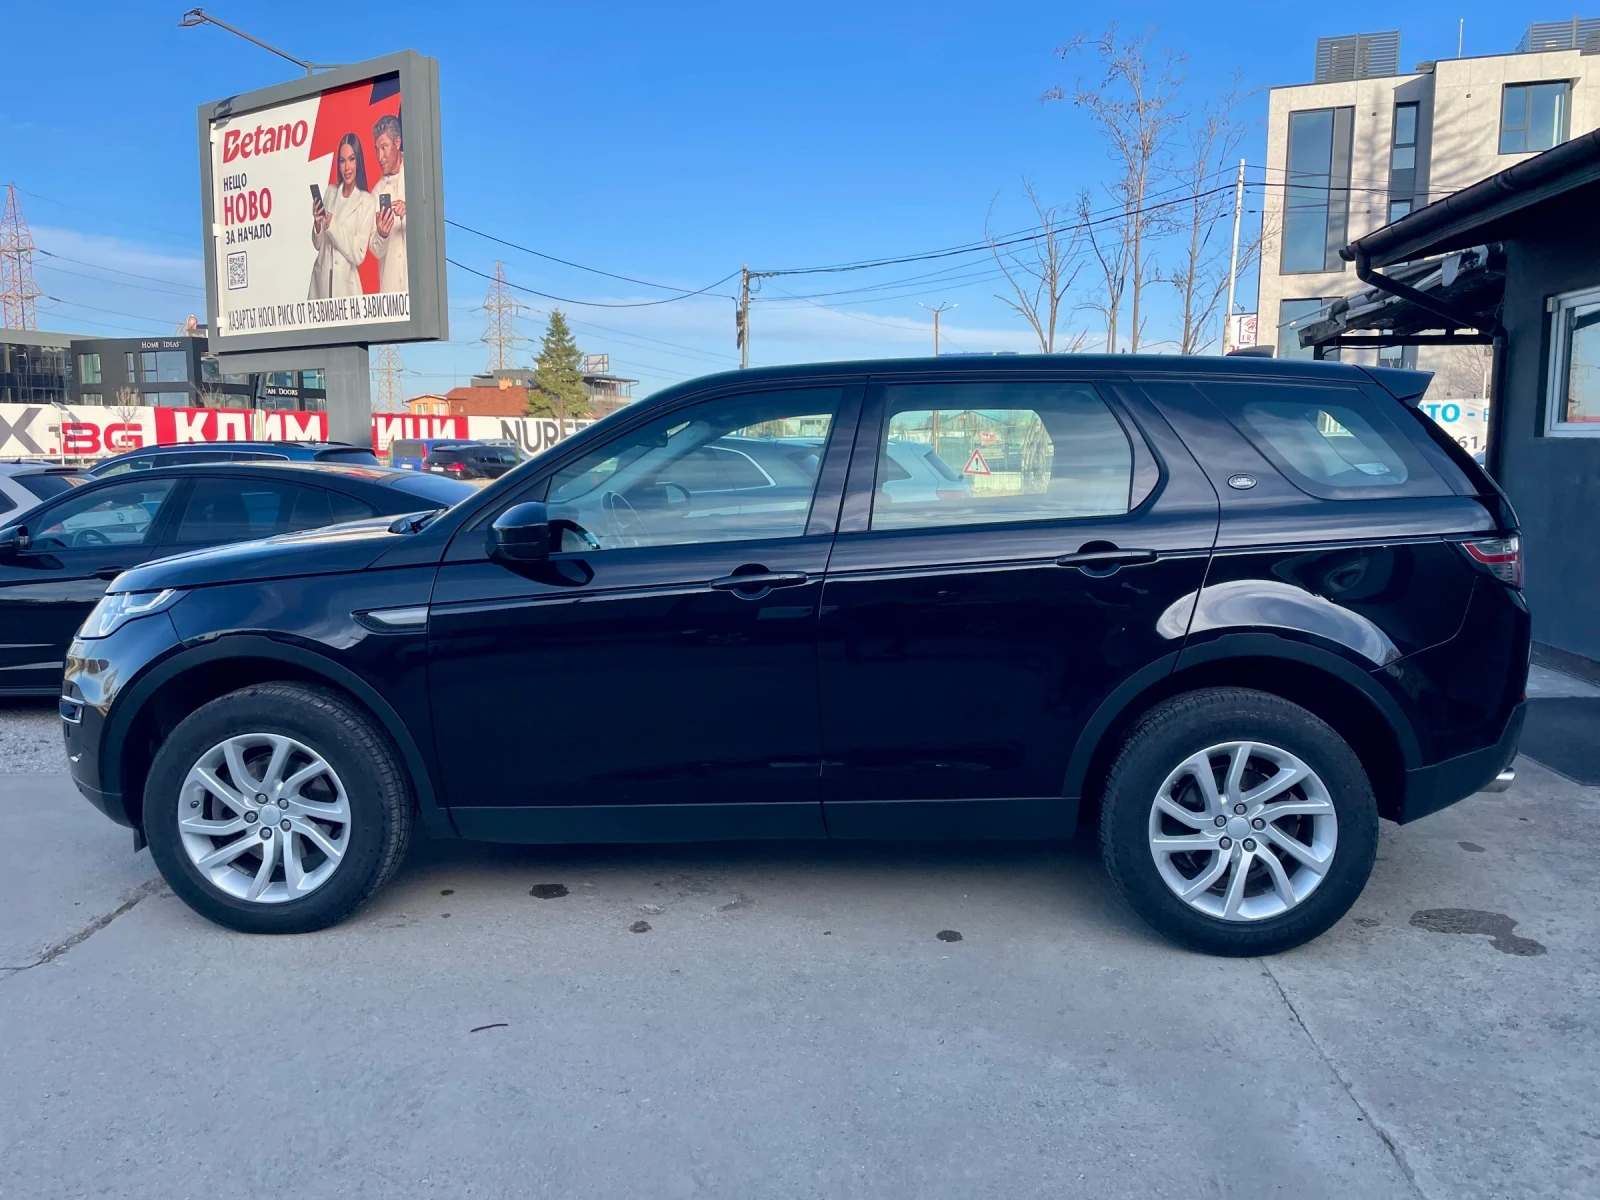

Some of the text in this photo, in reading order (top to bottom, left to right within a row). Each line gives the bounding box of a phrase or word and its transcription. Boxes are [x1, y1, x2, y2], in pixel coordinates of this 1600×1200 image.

[222, 120, 308, 164] Betano
[223, 173, 247, 191] НЕЩО
[224, 187, 272, 226] НОВО
[226, 223, 272, 245] ЗА НАЧАЛО
[228, 308, 256, 331] ХАЗАРТЪТ
[258, 305, 276, 328] НОСИ
[277, 303, 296, 326] РИСК
[297, 302, 306, 325] ОТ
[307, 299, 348, 323] РАЗВИВАНЕ
[350, 298, 361, 320] НА
